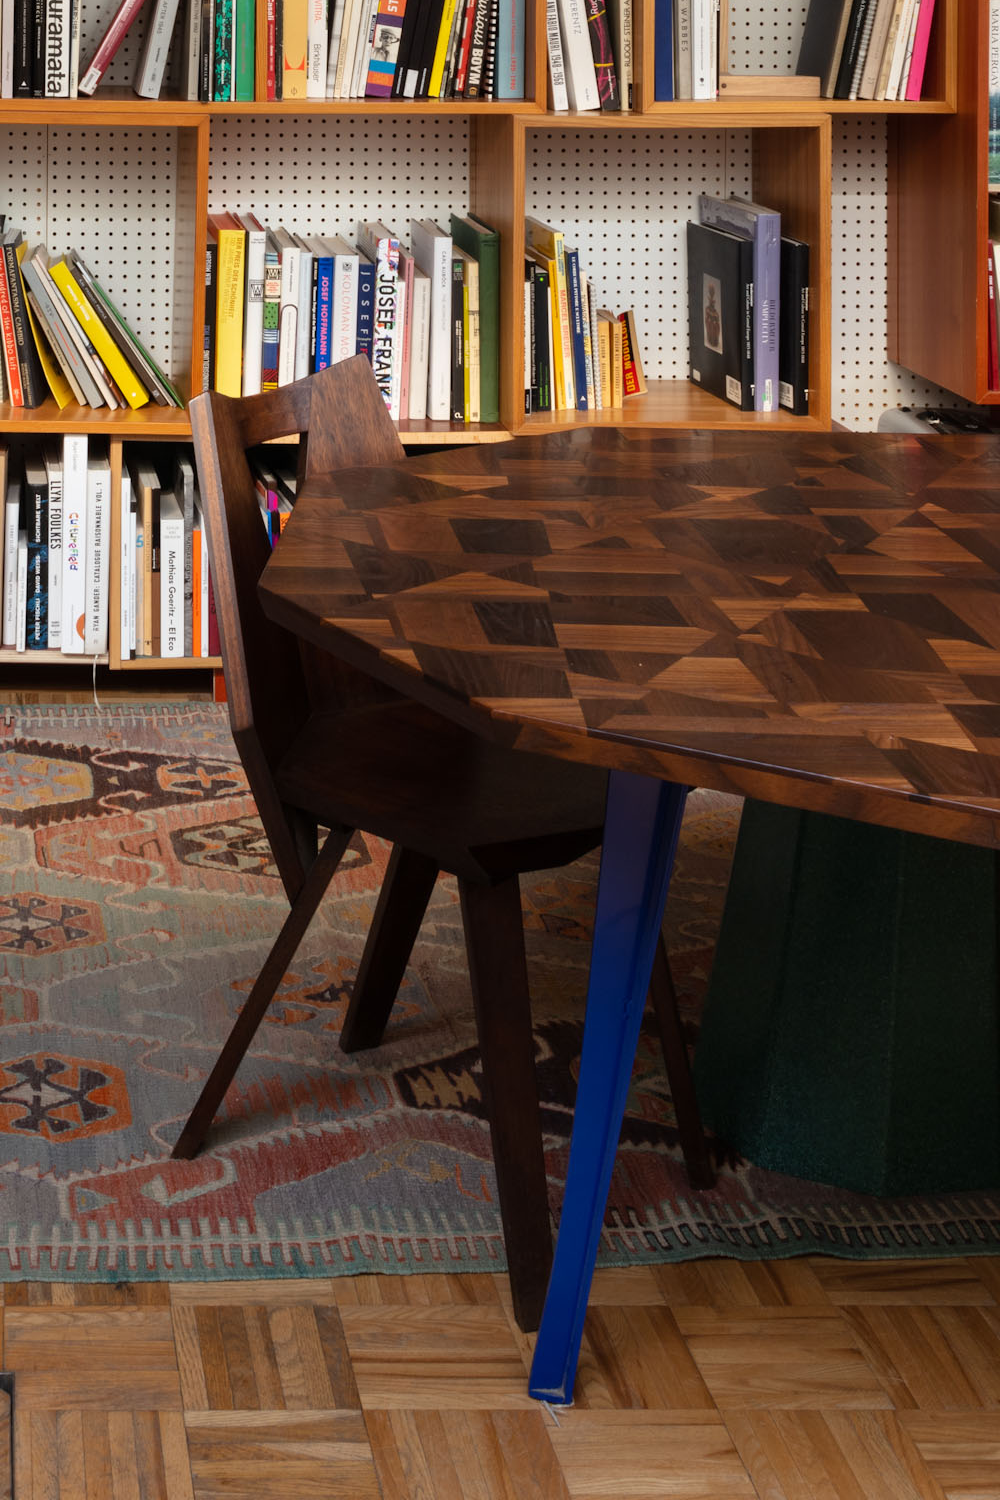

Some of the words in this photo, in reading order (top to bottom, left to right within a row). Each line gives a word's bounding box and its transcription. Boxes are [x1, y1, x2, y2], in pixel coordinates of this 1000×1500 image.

[159, 1, 168, 20] AFTER
[623, 8, 632, 36] STEINER
[312, 43, 322, 82] Birkhäuser
[469, 48, 484, 84] BOYM
[624, 38, 632, 68] RUDOLF
[6, 246, 20, 314] FORMAFANTASMA
[14, 317, 24, 346] CAMBIO
[321, 275, 330, 302] JOSEF
[340, 274, 352, 334] KOLOMAN
[361, 271, 370, 334] JOSEF
[377, 274, 396, 330] JOSEF
[1, 305, 10, 314] of
[560, 289, 568, 324] MARCEL
[3, 316, 12, 330] the
[319, 304, 330, 356] HOFFMANN
[5, 333, 16, 354] kibbo
[8, 356, 18, 370] kift
[375, 338, 394, 398] FRANK
[50, 480, 62, 504] LLYN
[50, 508, 62, 550] FOULKES
[168, 550, 176, 584] Mathias
[168, 586, 176, 618] Goeritz
[168, 627, 176, 636] El
[168, 636, 176, 652] Eco
